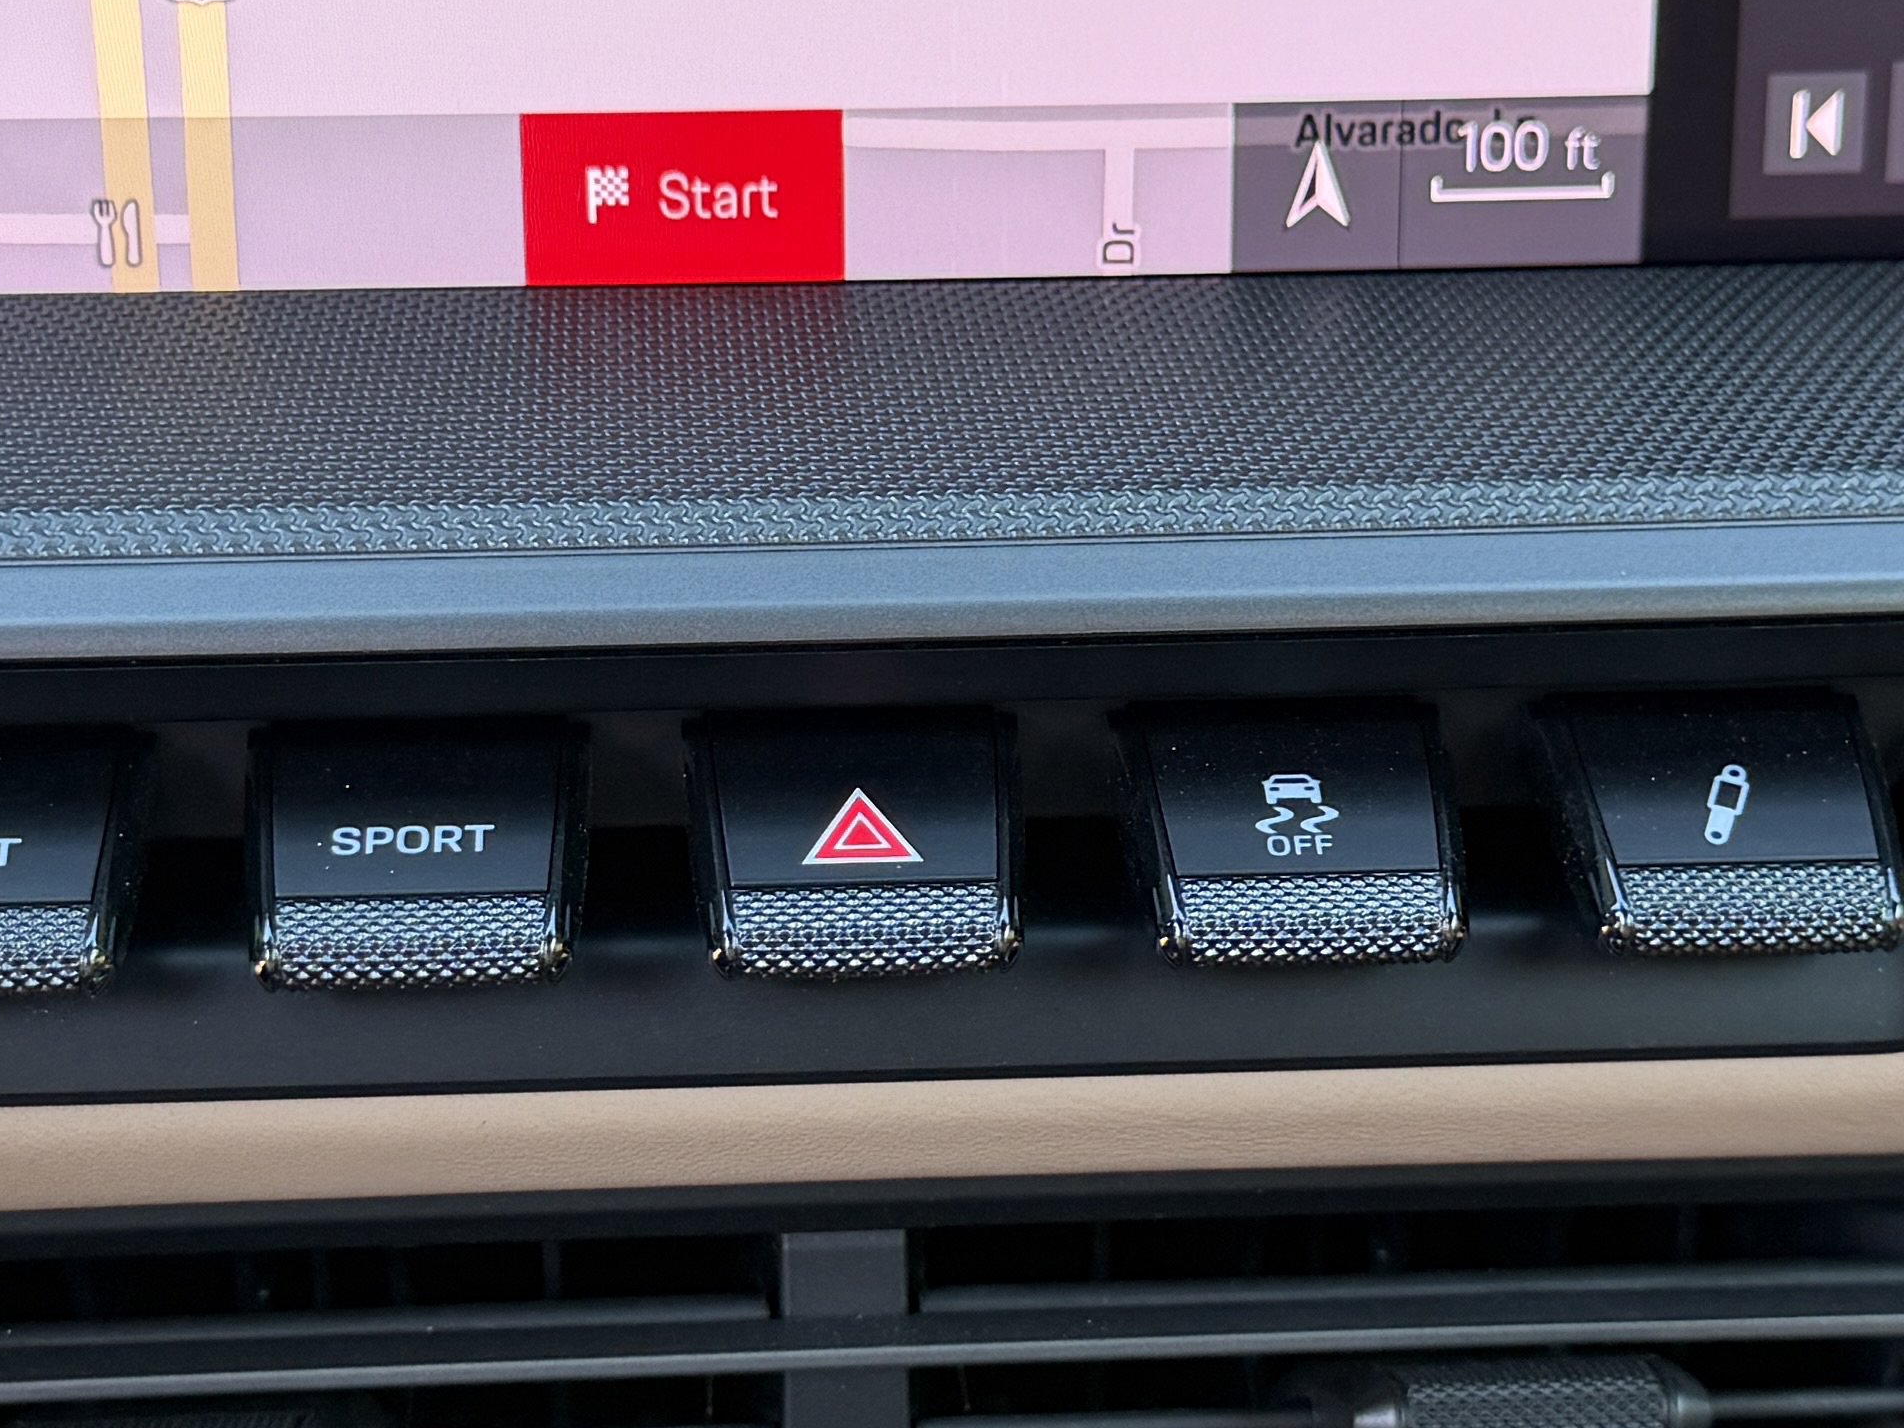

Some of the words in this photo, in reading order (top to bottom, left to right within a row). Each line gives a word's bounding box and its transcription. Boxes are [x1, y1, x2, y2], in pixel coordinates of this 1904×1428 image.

[1458, 121, 1549, 173] 100
[1564, 124, 1601, 171] ft
[656, 172, 780, 222] Start
[1102, 220, 1136, 266] Dr
[330, 824, 496, 857] SPORT
[1266, 834, 1334, 857] OFF
